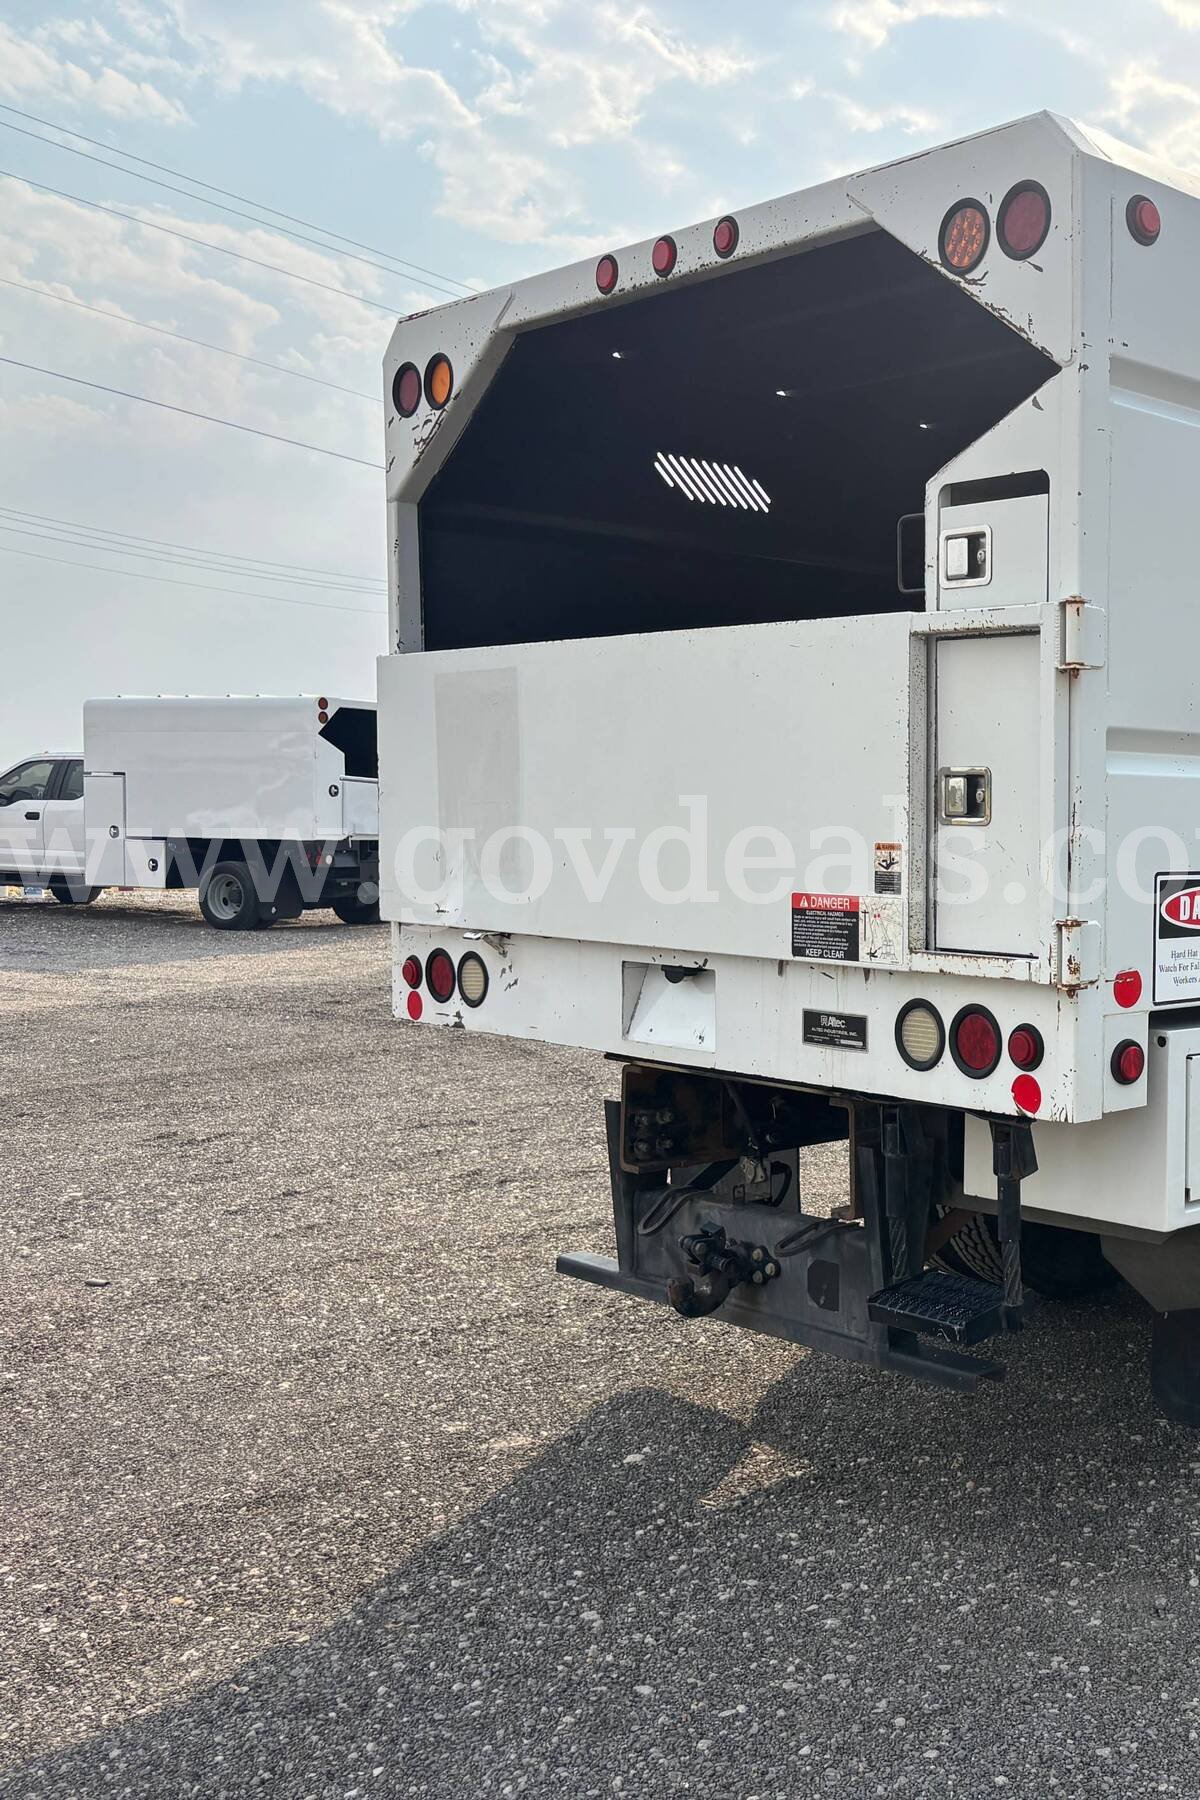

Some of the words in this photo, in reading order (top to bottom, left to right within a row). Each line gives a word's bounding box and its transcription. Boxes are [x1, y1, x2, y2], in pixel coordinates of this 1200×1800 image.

[810, 896, 850, 910] DANGER
[805, 948, 822, 957] KEEP
[823, 949, 845, 959] CLEAR
[1171, 950, 1186, 959] Hard
[1187, 949, 1198, 957] Hat
[1159, 963, 1177, 973] Watch
[1178, 963, 1189, 972] For
[1173, 976, 1198, 985] Workers
